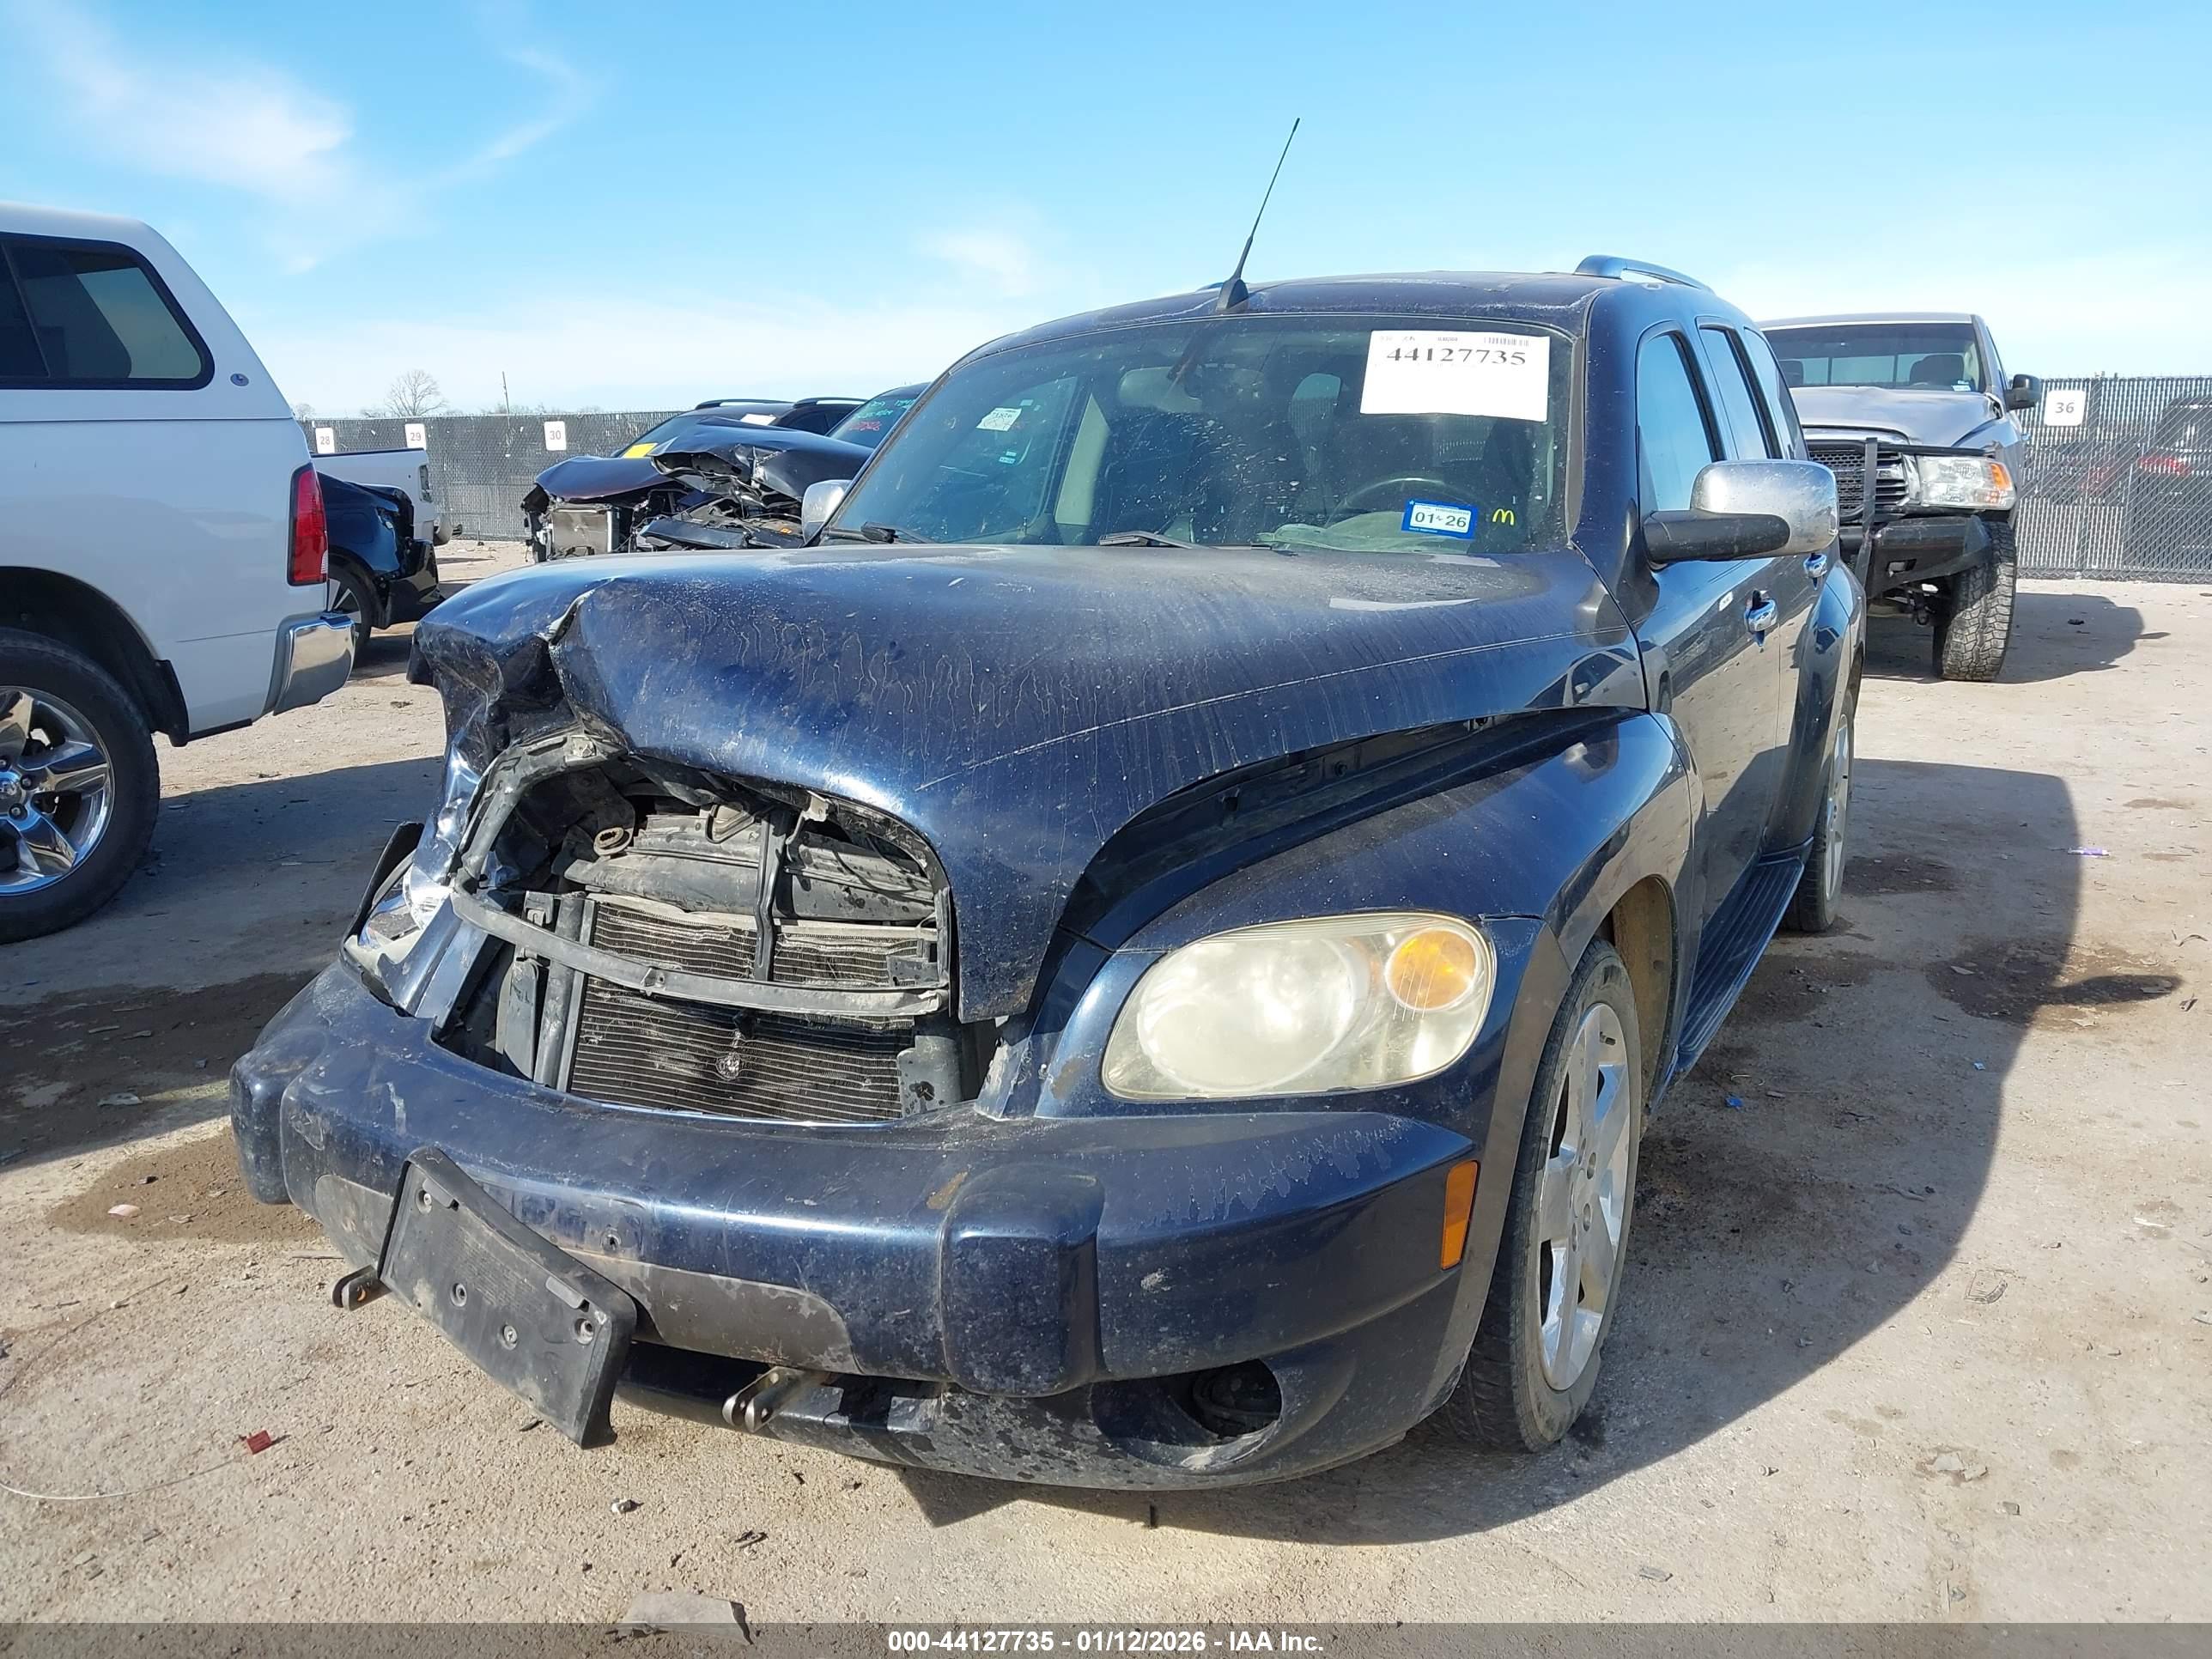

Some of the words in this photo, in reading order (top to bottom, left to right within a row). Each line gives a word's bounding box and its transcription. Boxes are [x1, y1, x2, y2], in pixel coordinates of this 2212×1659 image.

[1387, 348, 1526, 365] 44127735
[2055, 402, 2075, 414] 36
[320, 435, 331, 446] 28
[410, 432, 422, 441] 29
[550, 429, 562, 441] 30
